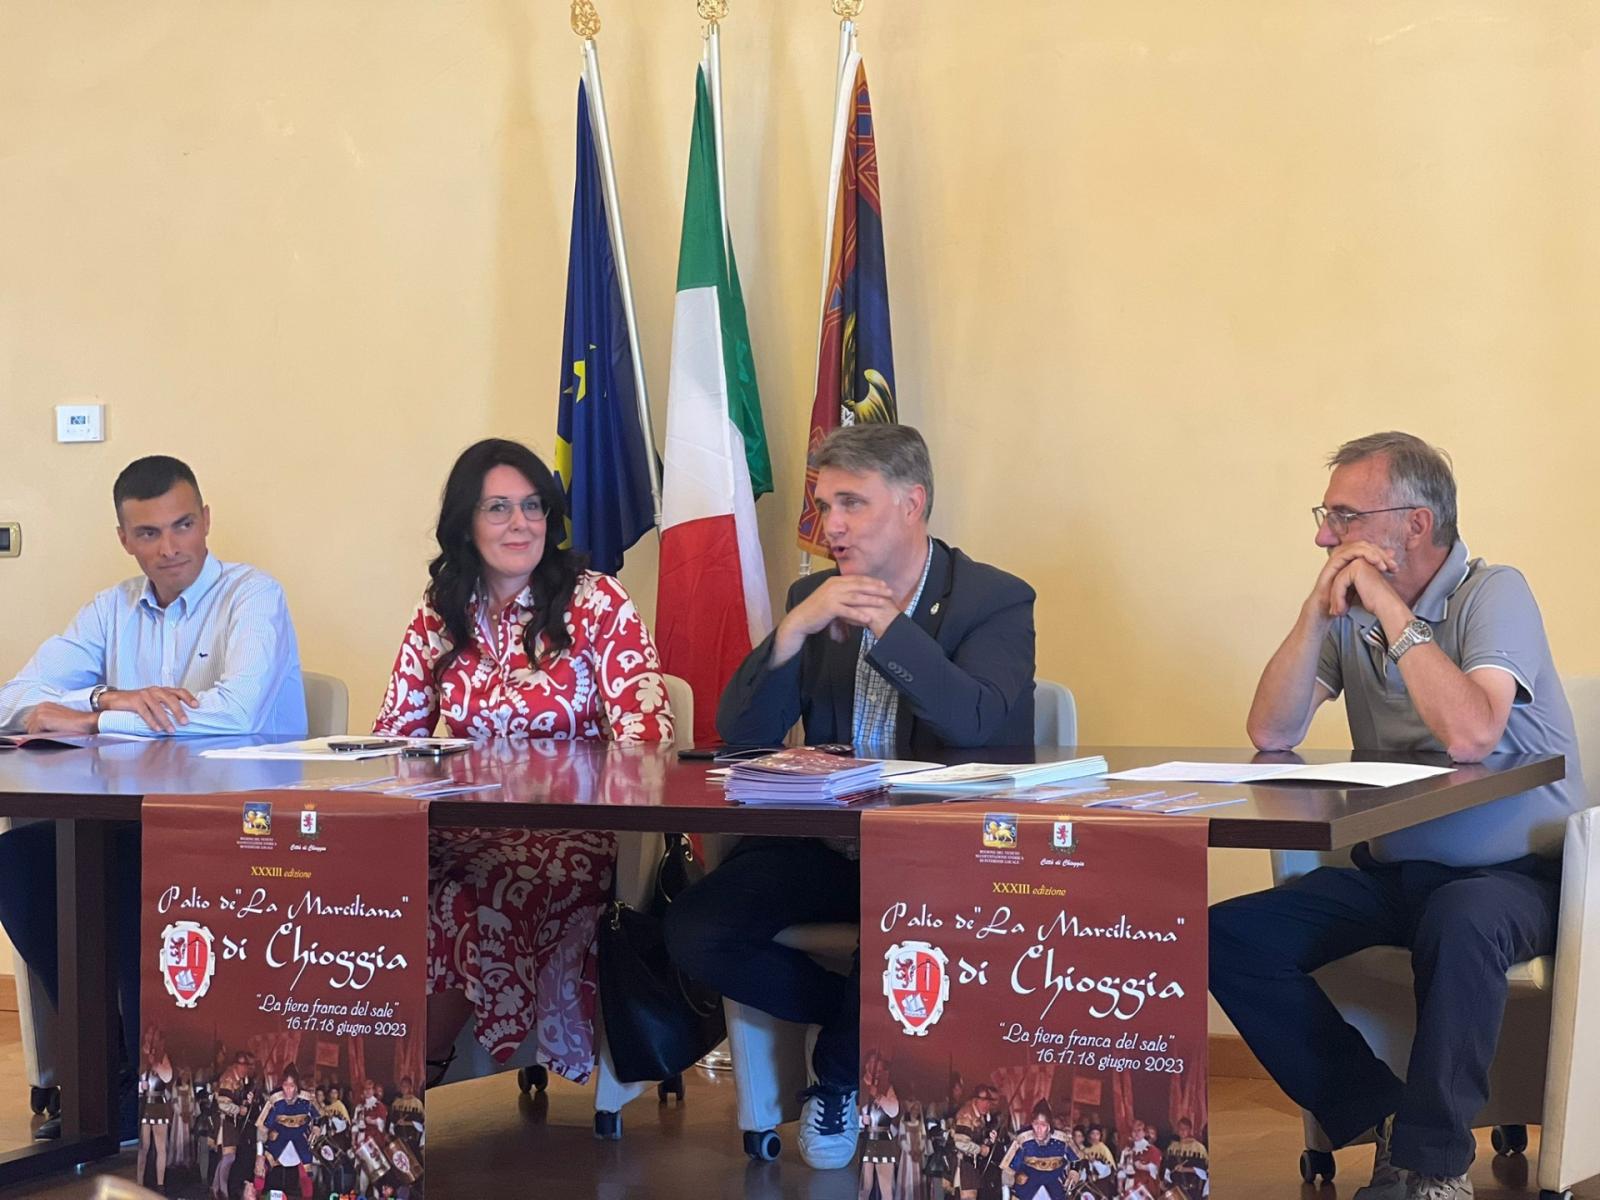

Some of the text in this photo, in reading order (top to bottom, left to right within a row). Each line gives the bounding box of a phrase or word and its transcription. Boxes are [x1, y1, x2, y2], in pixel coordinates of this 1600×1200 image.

[251, 866, 312, 879] XXXIII edizione
[992, 882, 1066, 896] XXXIII edizione
[157, 886, 210, 913] Palio
[287, 890, 409, 919] Marciliana"
[880, 901, 944, 933] Palio
[1037, 909, 1185, 942] Marciliana"
[222, 921, 408, 991] di Chioggia
[958, 944, 1185, 1020] di Chioggia
[281, 997, 310, 1016] fiera
[309, 998, 348, 1018] franca
[350, 1000, 370, 1017] del
[286, 1016, 407, 1037] 16.17.18 giugno 2023
[1030, 1026, 1064, 1048] fiera
[1064, 1028, 1112, 1050] franca
[1115, 1031, 1139, 1050] del
[1036, 1048, 1184, 1074] 16.17.18 giugno 2023
